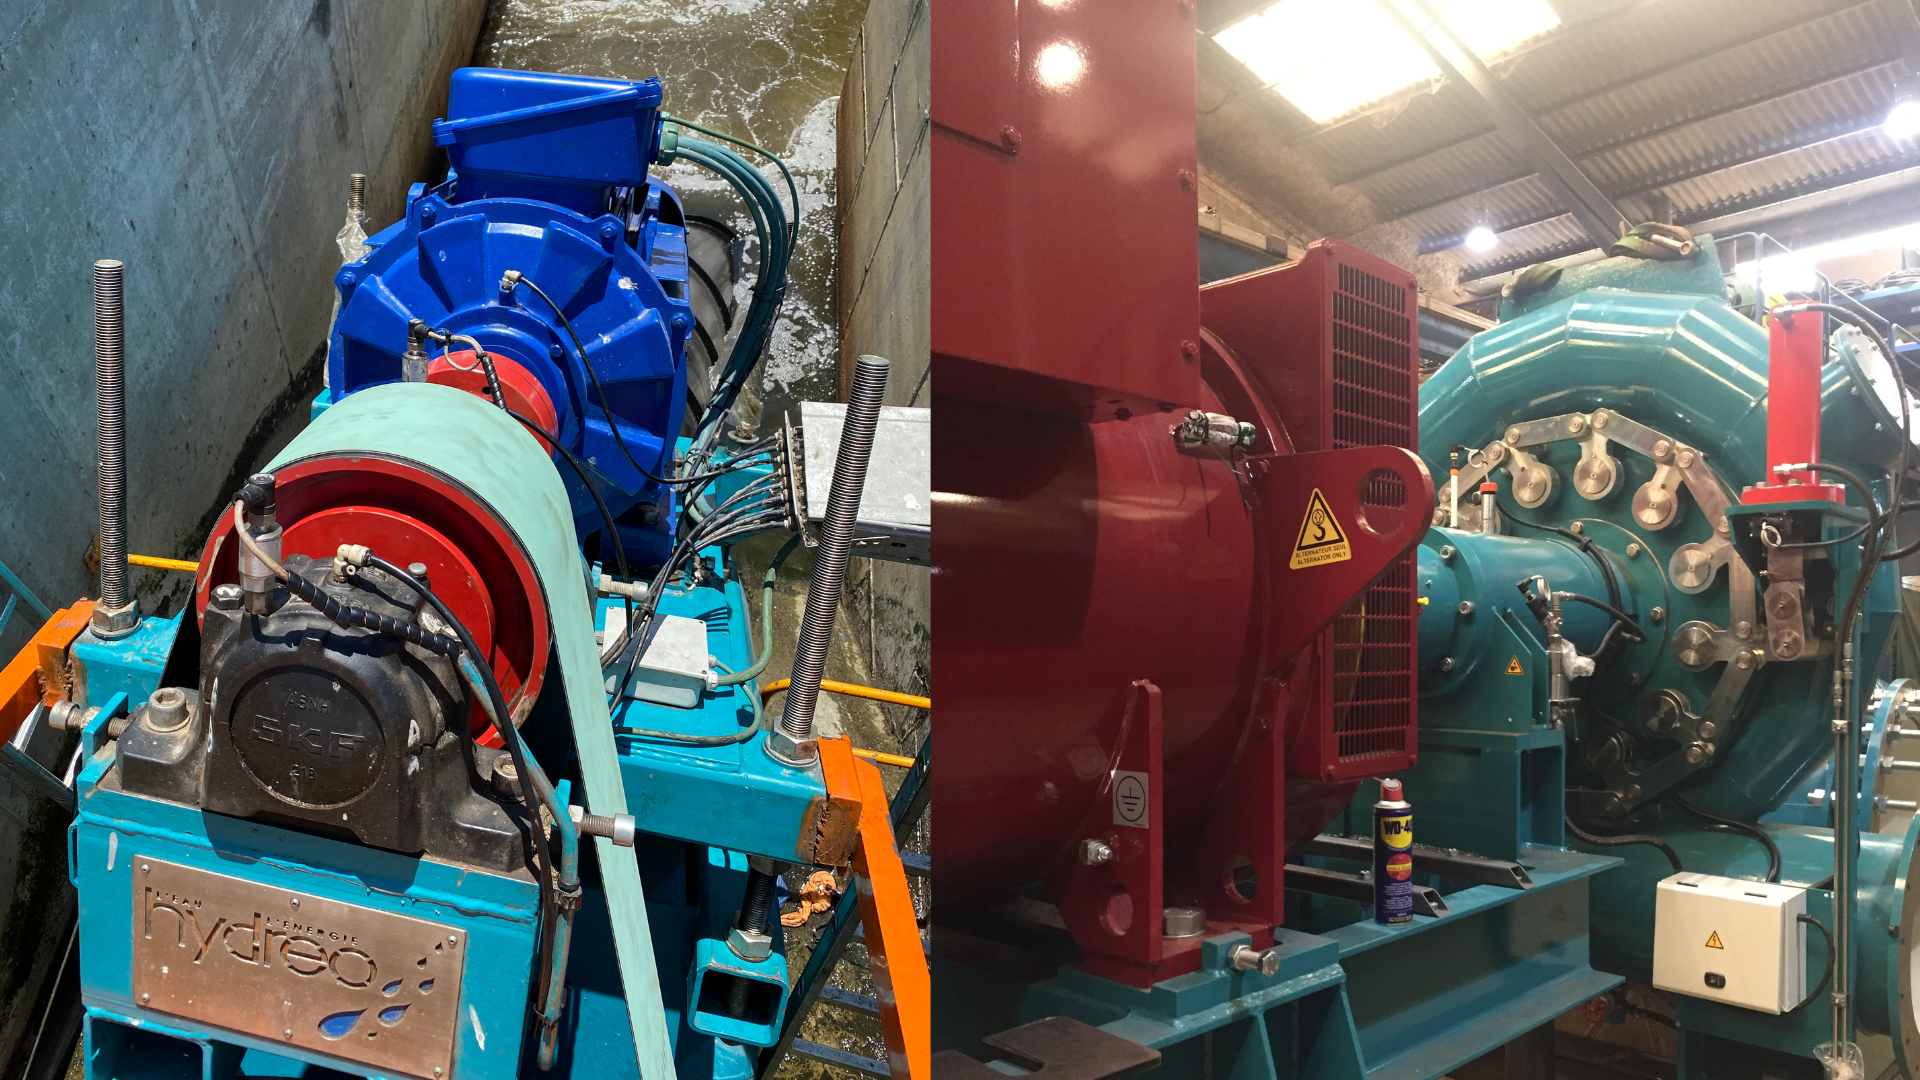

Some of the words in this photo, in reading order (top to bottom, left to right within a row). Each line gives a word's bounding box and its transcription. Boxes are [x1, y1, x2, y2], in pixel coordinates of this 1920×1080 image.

[1296, 547, 1332, 558] ALTERNATEUR
[1297, 555, 1331, 565] ALTERNATOR
[285, 692, 331, 714] ASNH
[251, 714, 366, 758] SKF
